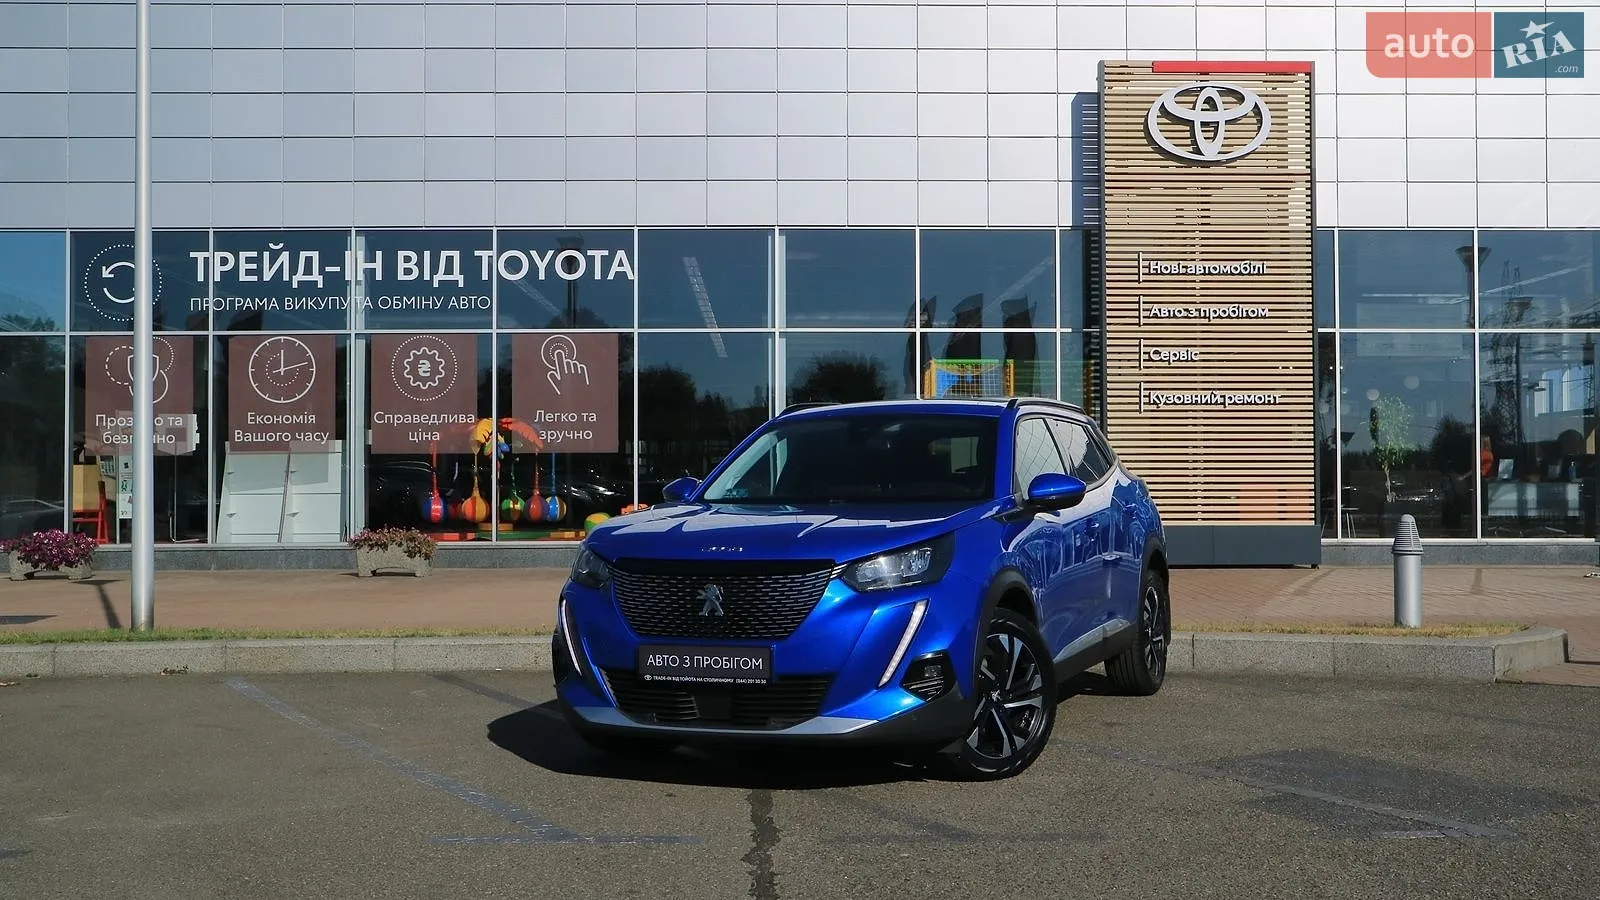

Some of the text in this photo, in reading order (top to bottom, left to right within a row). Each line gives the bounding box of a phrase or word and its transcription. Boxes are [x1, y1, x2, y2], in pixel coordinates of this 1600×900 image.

[189, 242, 635, 289] ТРЕЙД-ІН ВІД TOYOTA
[1149, 260, 1268, 275] Нові автомобілі
[190, 295, 491, 311] ПРОГРАМА ВИКУПУ ТА ОБМІНУ АВТО
[1149, 304, 1269, 322] Авто з пробігом
[1149, 347, 1200, 364] Сервіс
[1149, 390, 1281, 408] Кузовний ремонт
[95, 414, 183, 430] Прозо та
[247, 411, 317, 424] Економія
[373, 411, 475, 426] Справедлива
[534, 410, 597, 423] Легко та
[234, 429, 330, 445] Вашого часу
[408, 428, 440, 442] ціна
[538, 429, 593, 445] зручно
[646, 654, 763, 670] АВТО З ПРОБІГОМ
